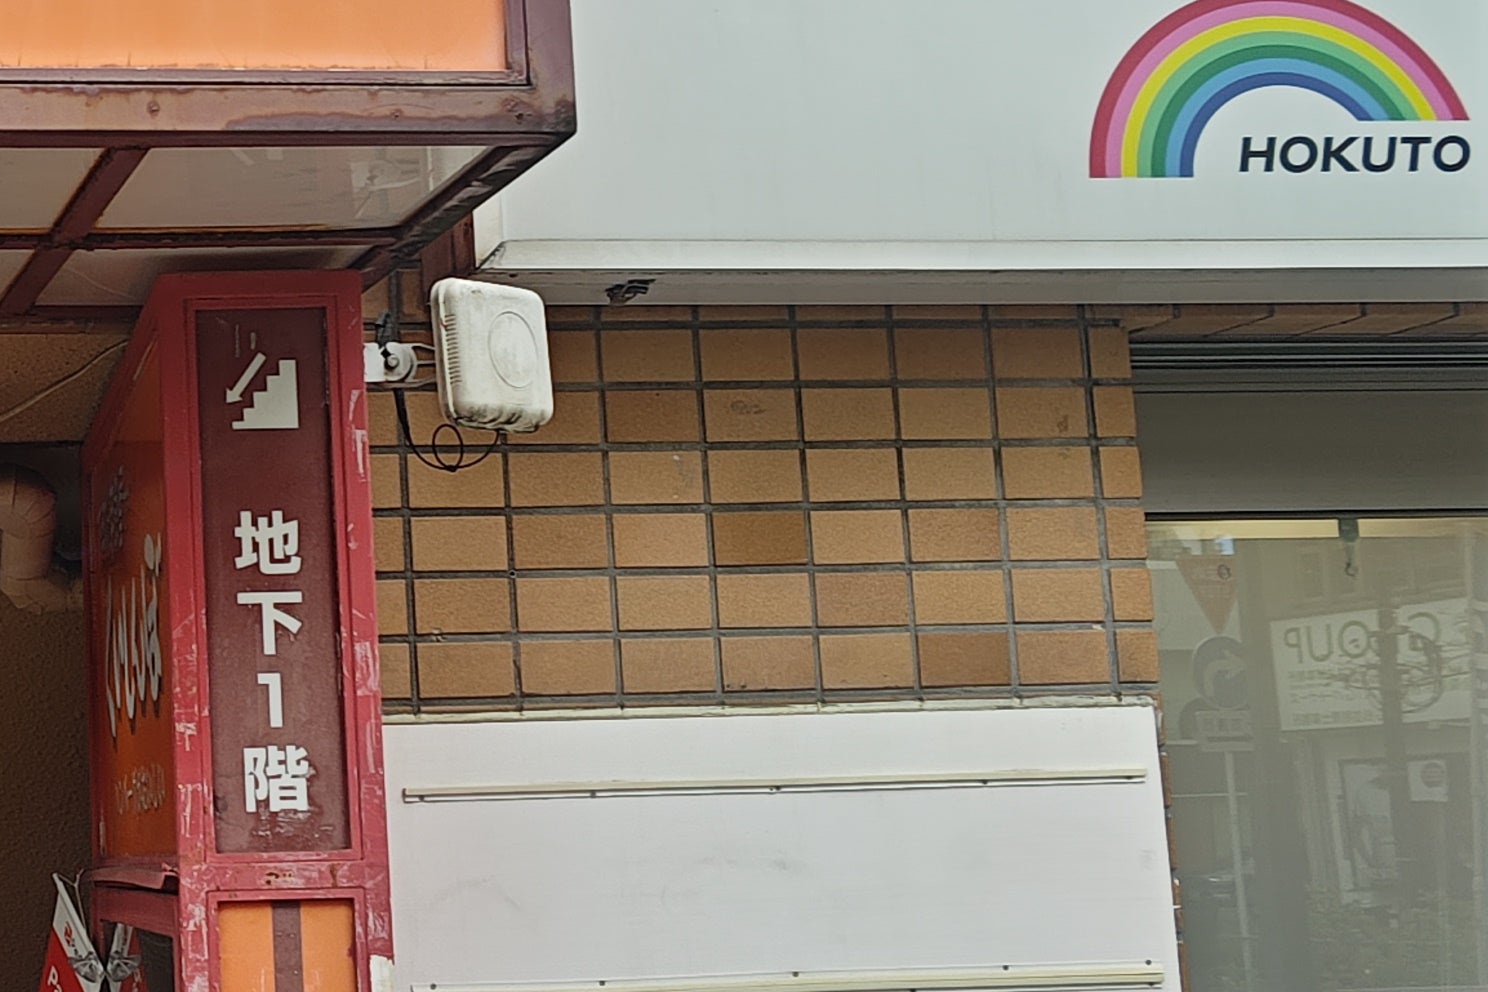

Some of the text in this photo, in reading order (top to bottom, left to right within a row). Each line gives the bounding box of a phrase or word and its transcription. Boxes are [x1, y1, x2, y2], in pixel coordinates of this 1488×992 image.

[1238, 135, 1471, 173] HOKUTO
[234, 509, 310, 814] 地下1階
